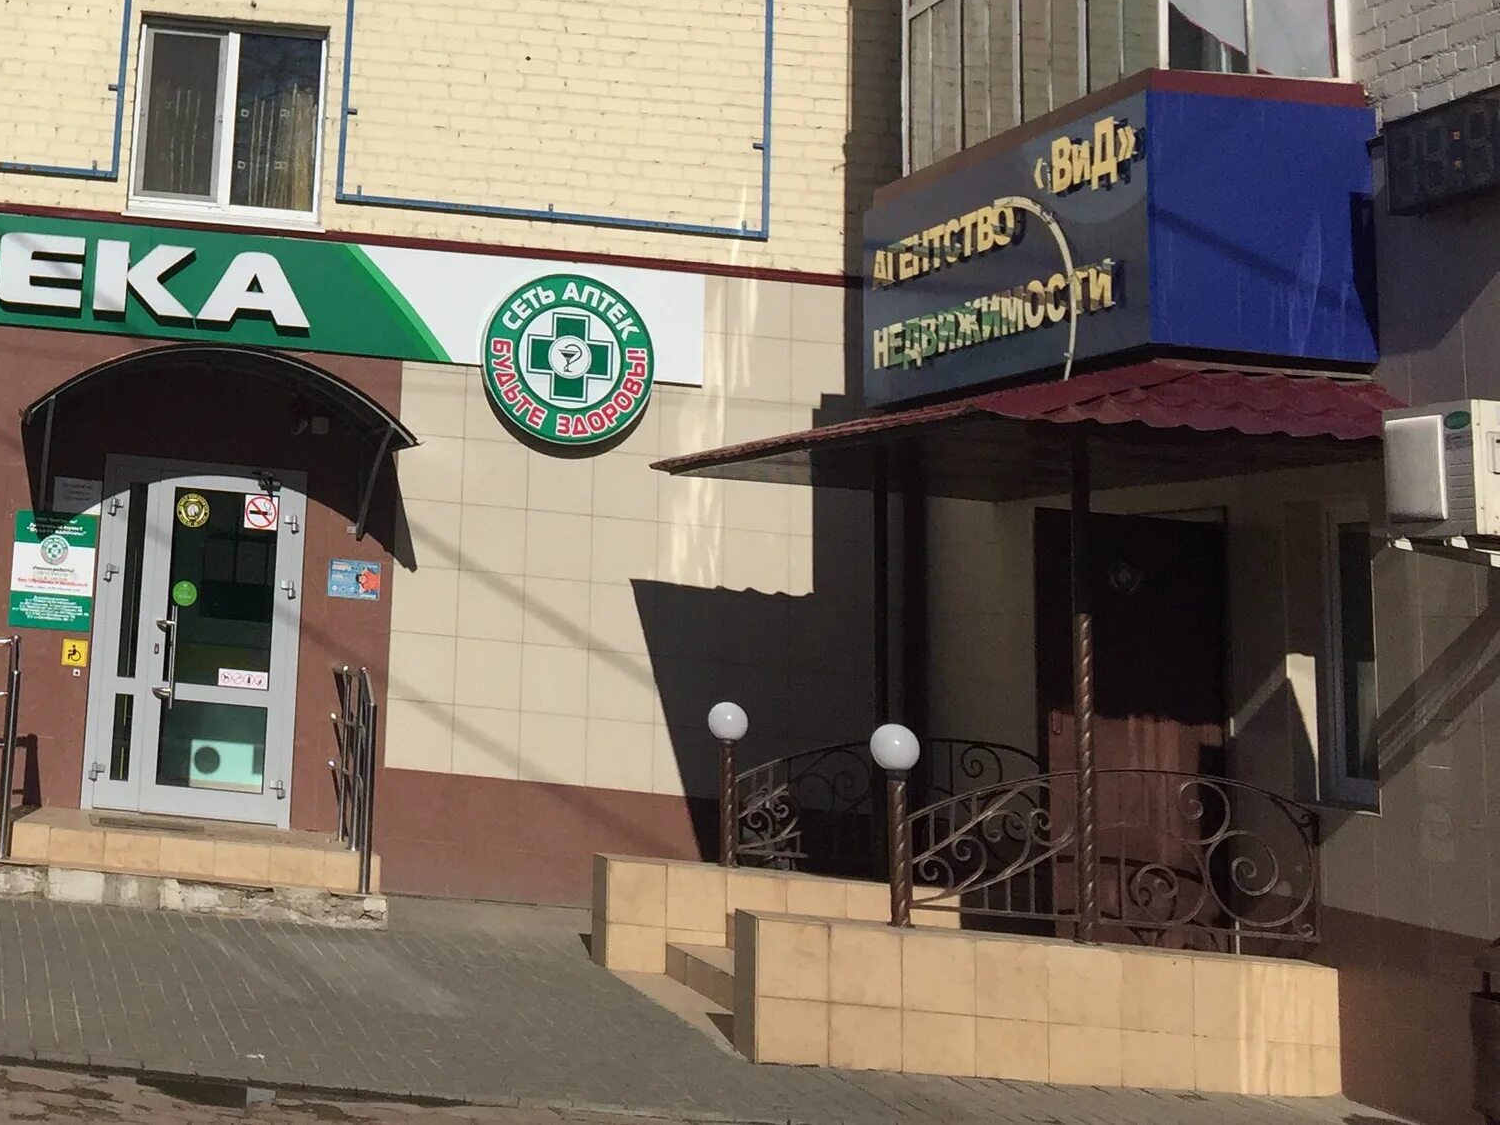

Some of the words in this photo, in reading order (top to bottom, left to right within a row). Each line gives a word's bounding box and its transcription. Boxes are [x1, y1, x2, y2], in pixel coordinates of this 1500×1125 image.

[872, 202, 1015, 290] АГЕНТСТВО
[502, 286, 556, 330] СЕТЬ
[562, 282, 640, 341] АПТЕК
[492, 338, 548, 428] БУДЬТЕ
